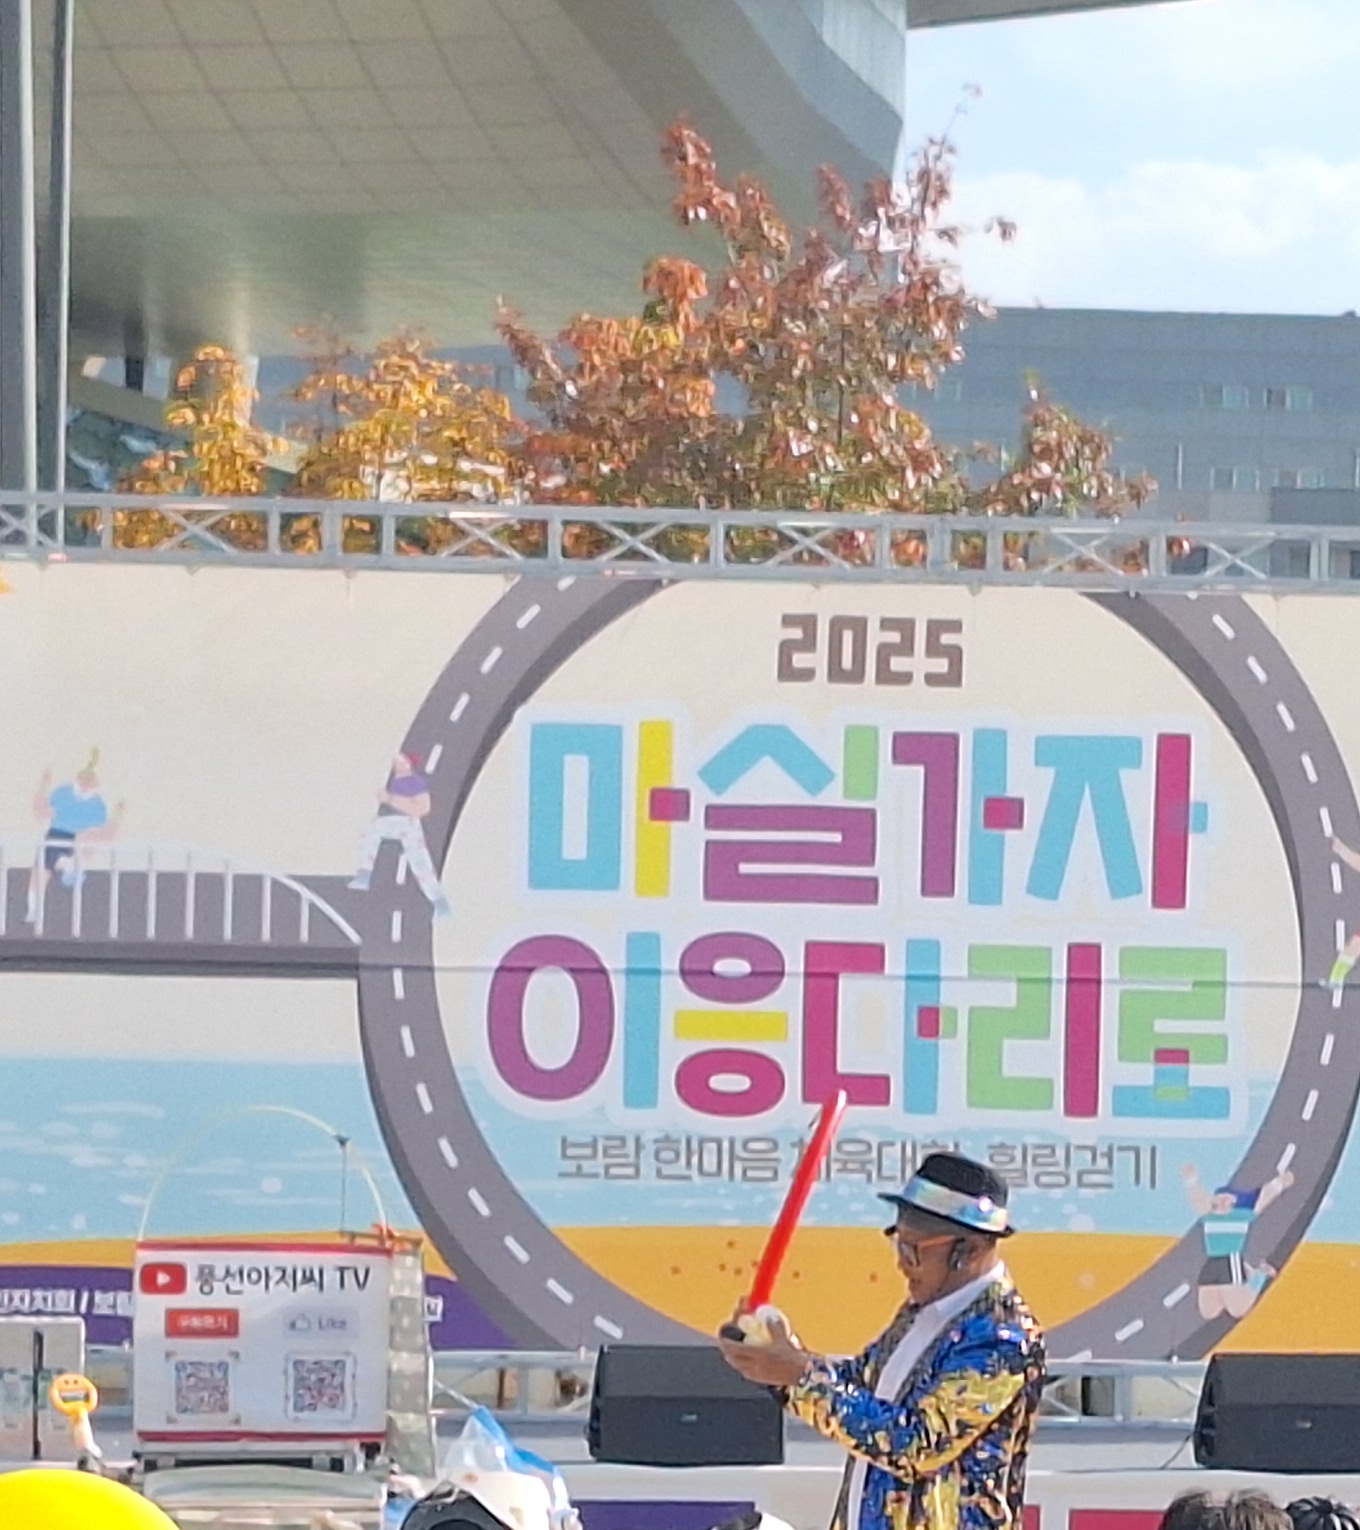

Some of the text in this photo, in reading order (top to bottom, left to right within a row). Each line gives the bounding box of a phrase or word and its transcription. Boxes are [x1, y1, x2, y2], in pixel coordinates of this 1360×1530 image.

[776, 613, 964, 688] 2025
[527, 718, 1208, 910] 마실가자
[487, 931, 1231, 1120] 이응다리로
[558, 1135, 644, 1181] 보람
[652, 1135, 782, 1183] 한마음
[335, 1265, 371, 1292] TV
